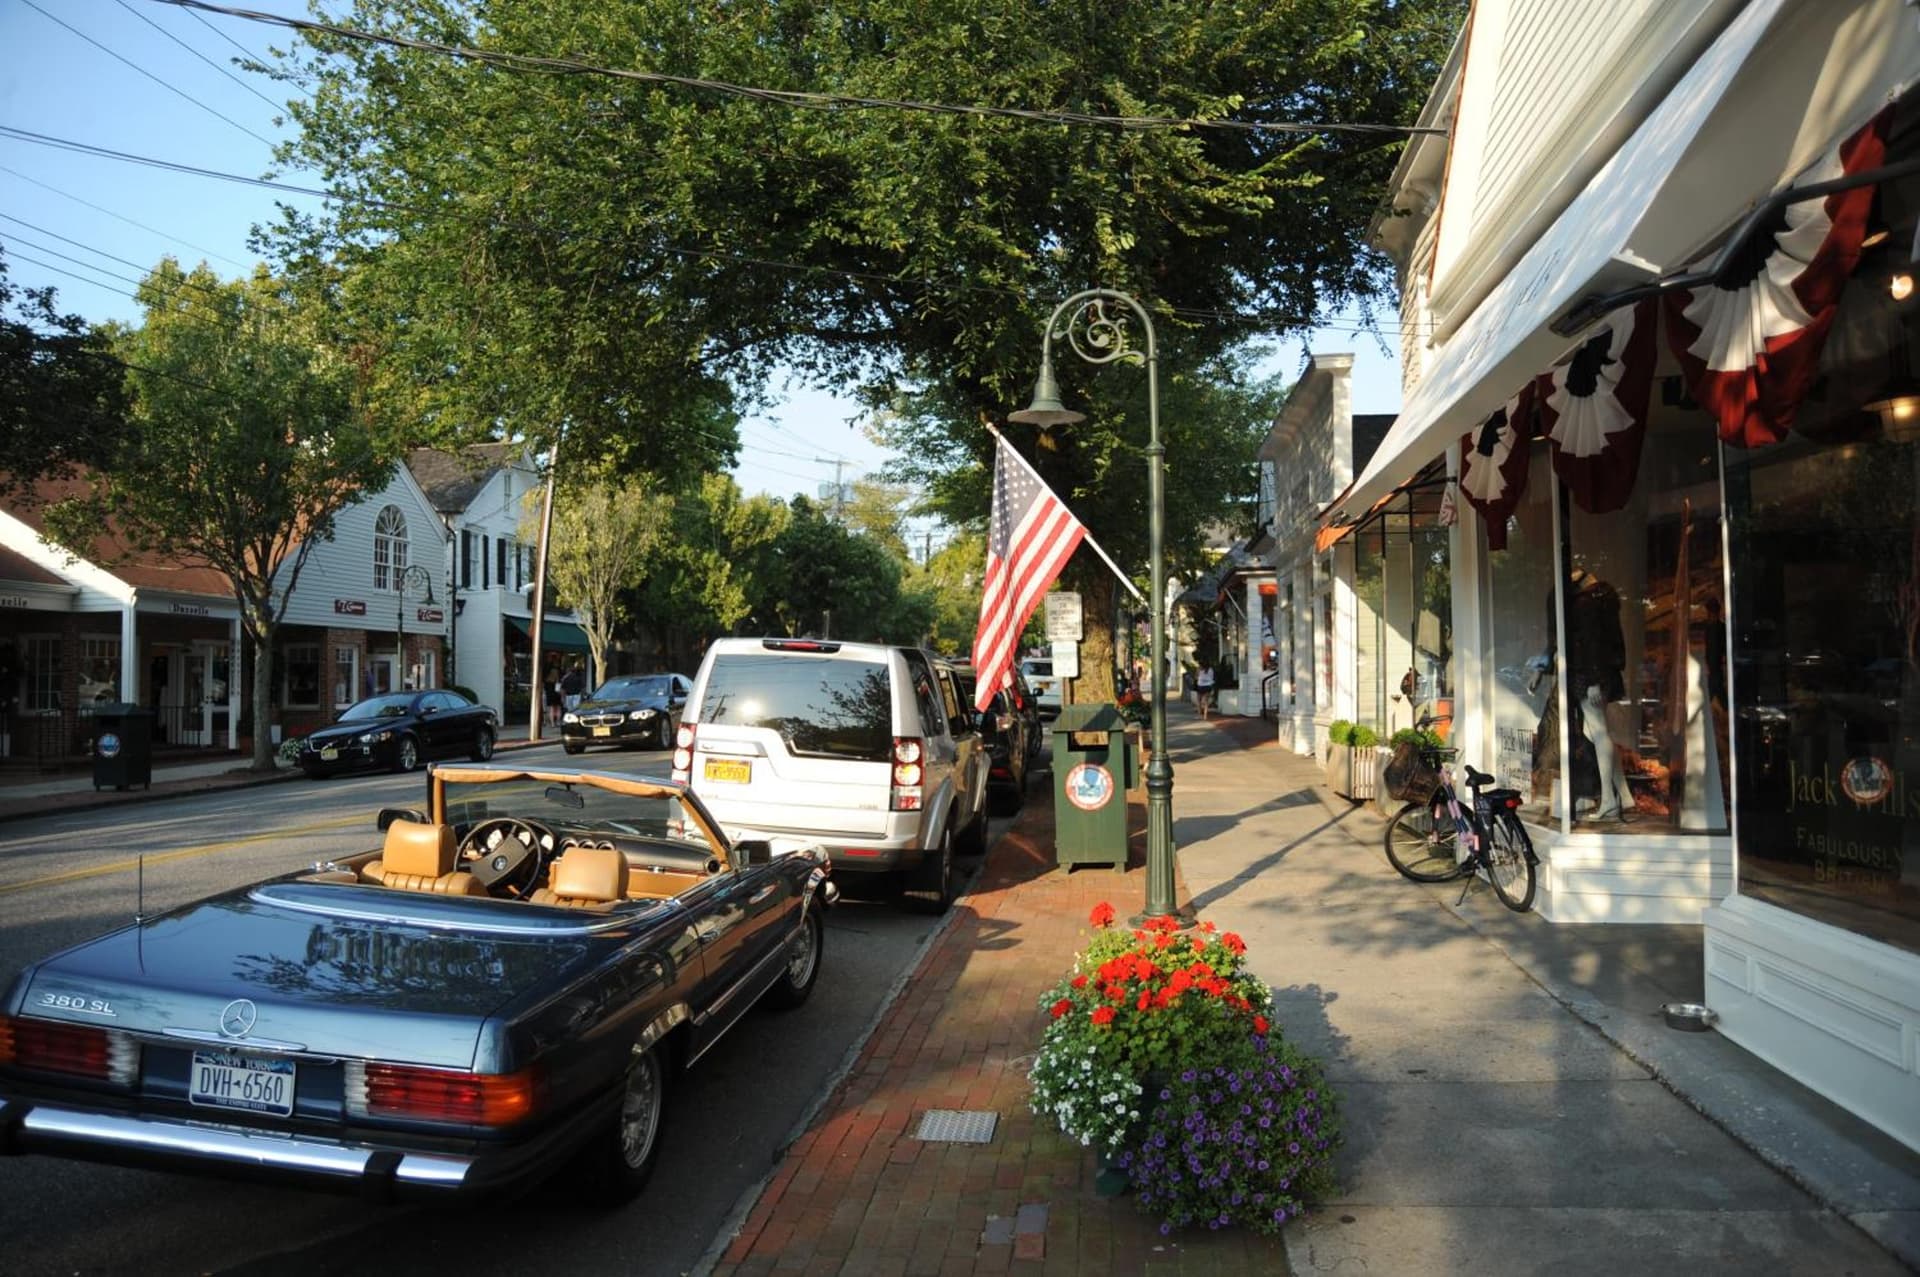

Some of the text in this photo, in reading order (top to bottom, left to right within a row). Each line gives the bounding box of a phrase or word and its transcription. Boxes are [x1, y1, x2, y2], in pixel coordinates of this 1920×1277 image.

[1786, 760, 1838, 813] Jack
[42, 993, 114, 1014] 380 SL
